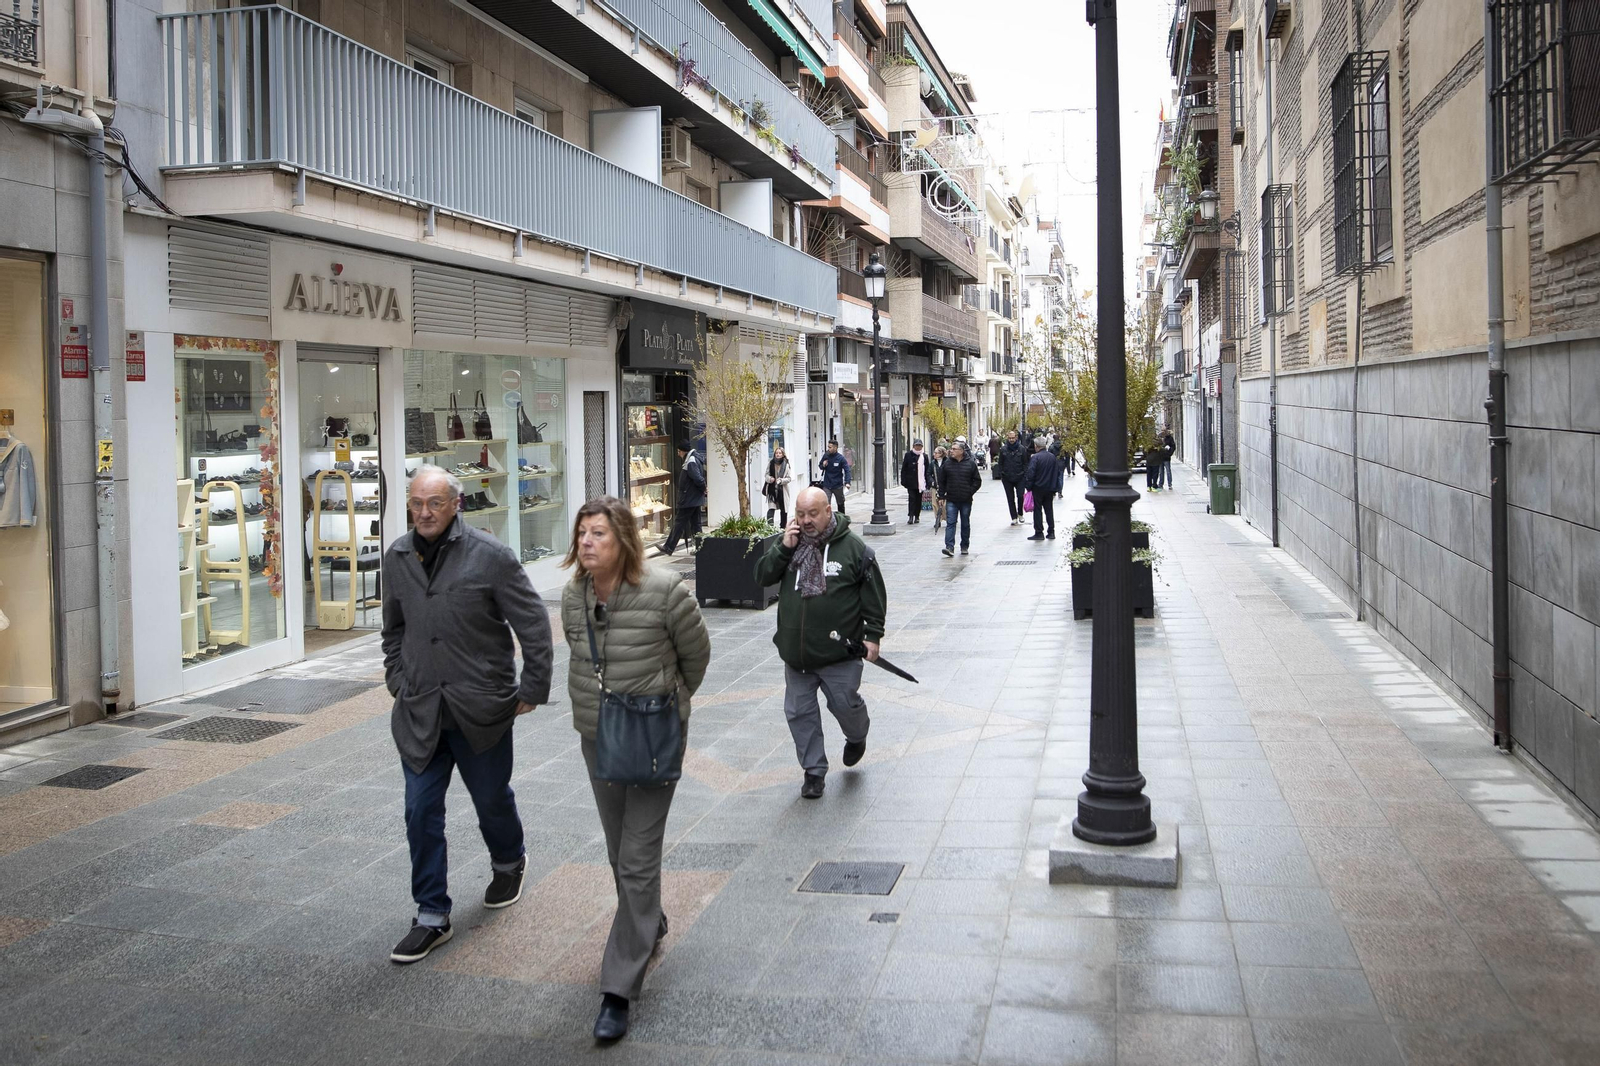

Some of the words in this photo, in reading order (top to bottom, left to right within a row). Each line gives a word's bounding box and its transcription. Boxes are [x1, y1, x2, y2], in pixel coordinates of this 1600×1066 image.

[283, 273, 405, 322] ALIEVA
[64, 346, 86, 354] Alarma
[644, 329, 663, 349] PLATA
[676, 333, 694, 351] PLATA
